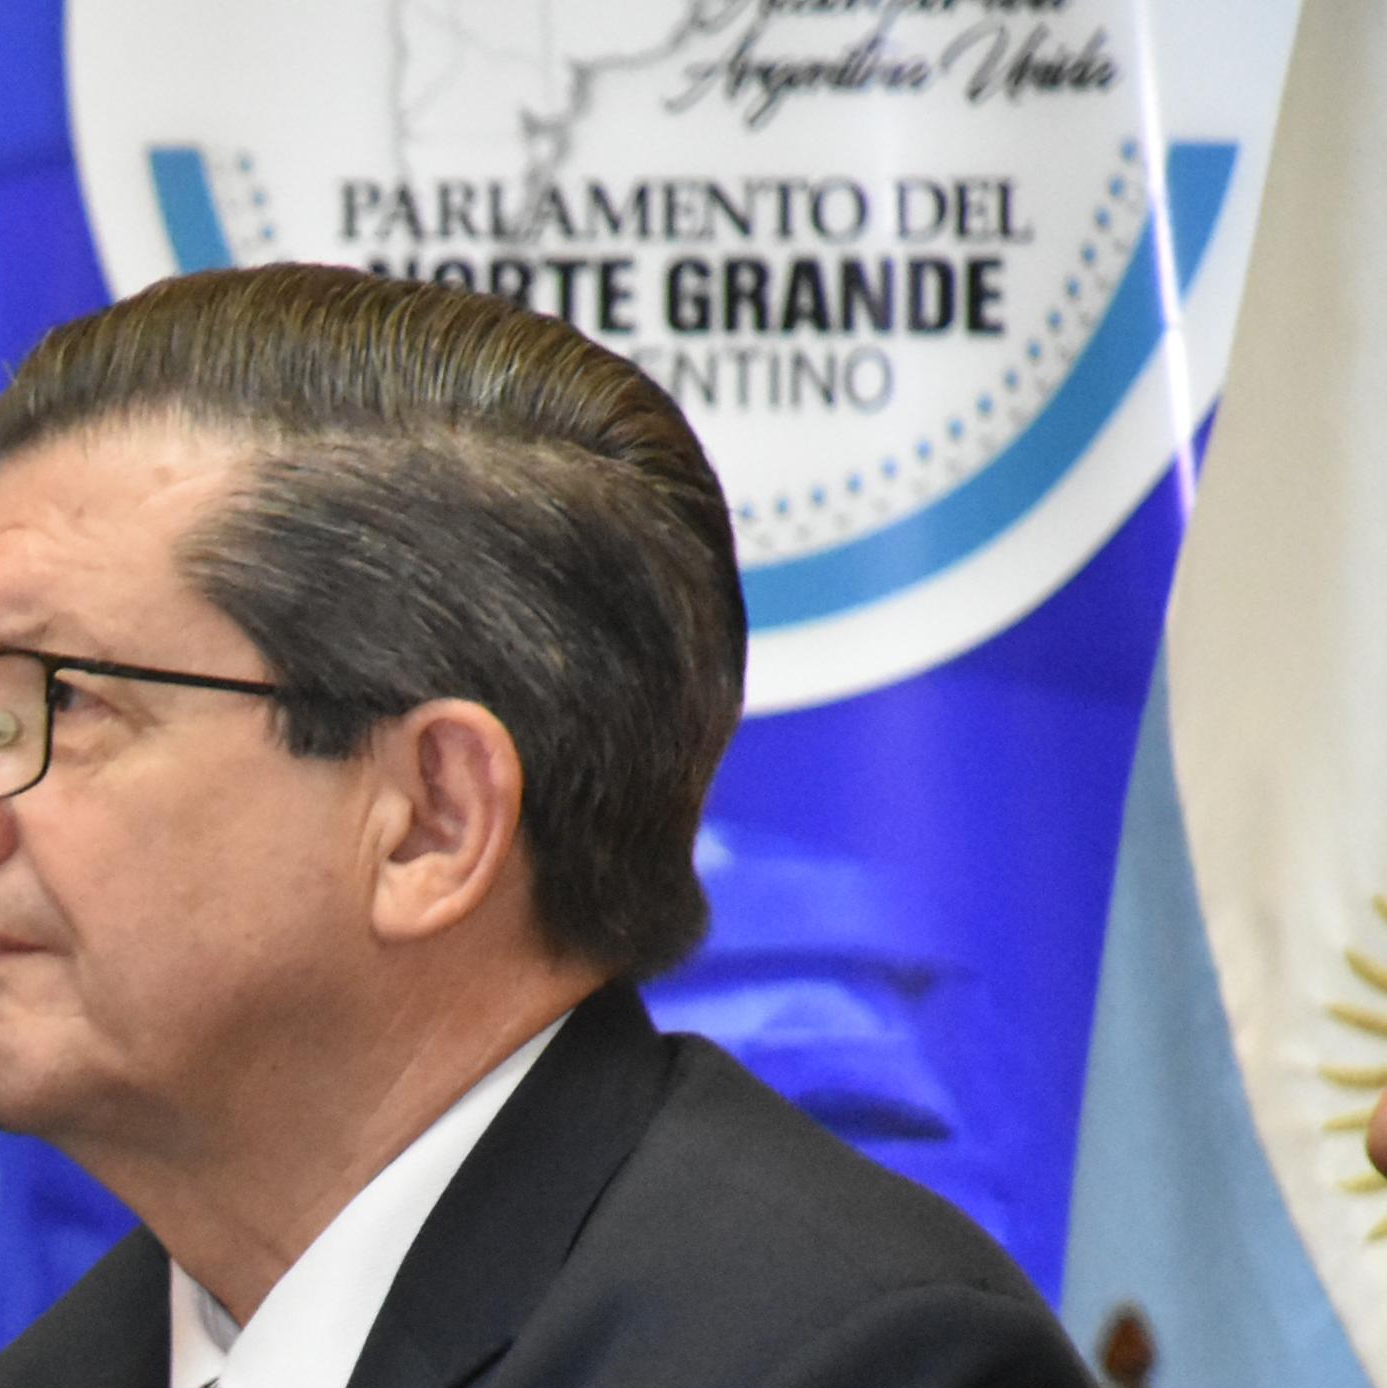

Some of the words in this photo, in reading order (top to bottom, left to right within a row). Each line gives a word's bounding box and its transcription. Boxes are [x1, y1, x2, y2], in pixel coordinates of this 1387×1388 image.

[339, 178, 867, 244] PARLAMENTO
[894, 178, 1034, 244] DEL
[664, 256, 1004, 337] GRANDE
